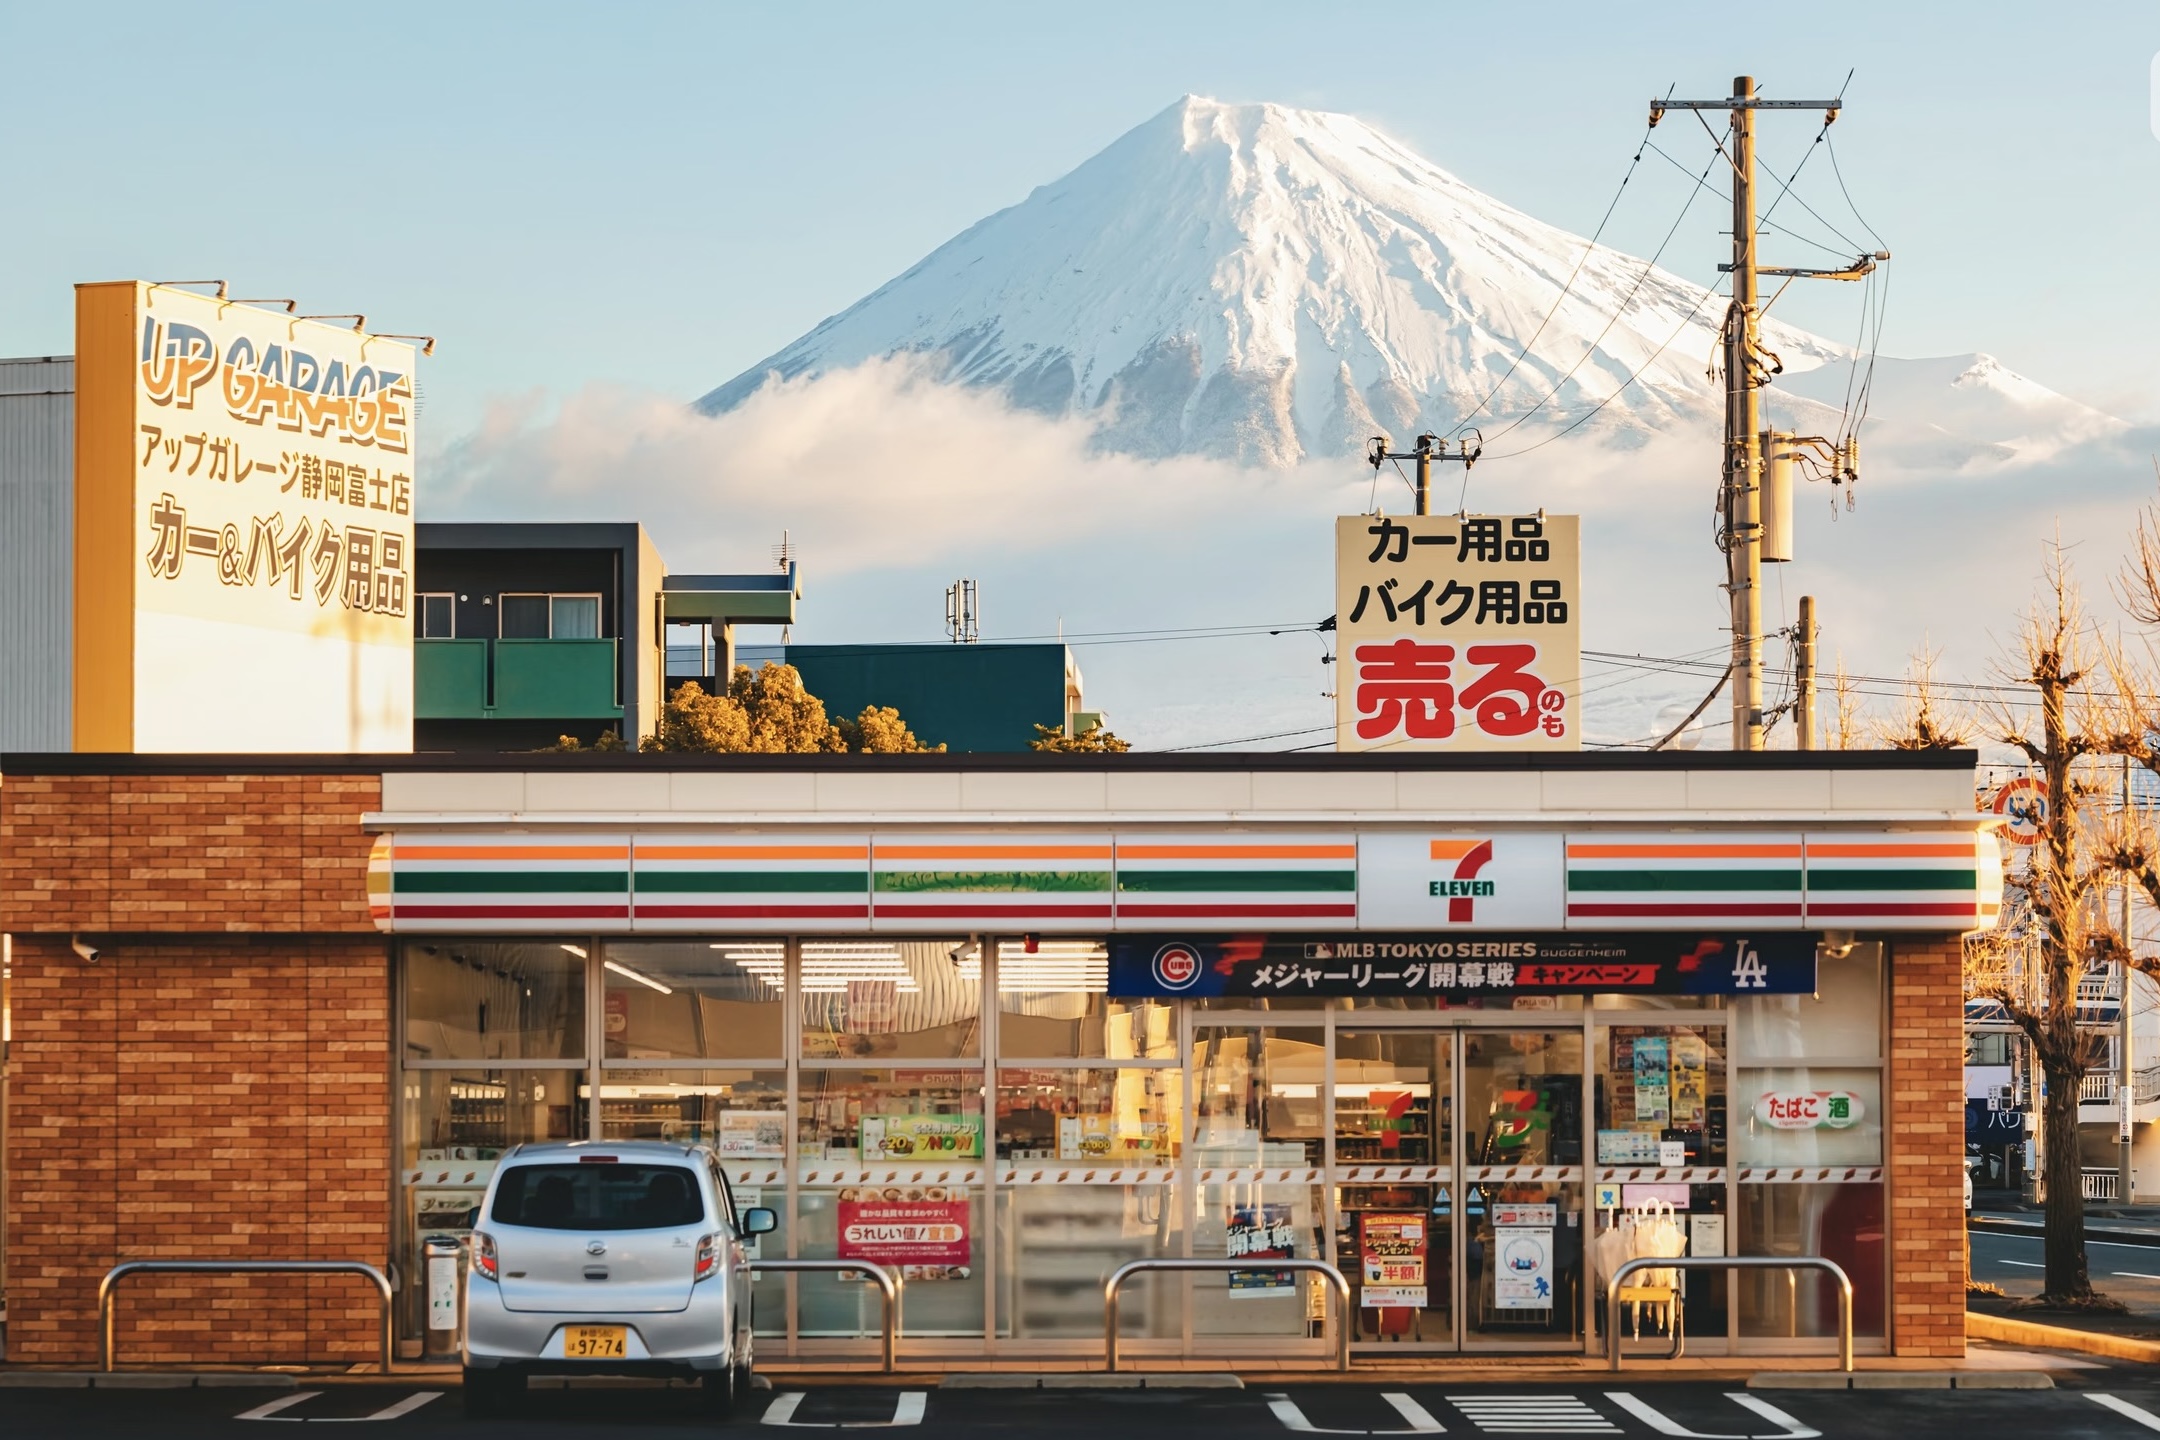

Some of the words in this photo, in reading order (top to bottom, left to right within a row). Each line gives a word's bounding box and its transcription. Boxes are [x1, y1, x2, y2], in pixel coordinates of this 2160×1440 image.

[141, 314, 218, 411] UP
[221, 336, 411, 455] GARAGE
[140, 423, 410, 516] アップガレージ静岡富士店
[1368, 518, 1550, 563] カー用品
[1349, 577, 1568, 626] バイク用品
[2009, 796, 2046, 826] 50
[1430, 839, 1493, 922] 7
[1161, 949, 1195, 983] CUBS
[1336, 943, 1375, 958] MLB
[1379, 943, 1454, 958] TOKYO
[1456, 942, 1537, 958] SERIES
[1731, 939, 1768, 988] LA
[1250, 962, 1515, 989] メジャーリーグ開幕戦
[1531, 965, 1641, 984] キャンペーン
[1769, 1097, 1819, 1119] たばこ
[1828, 1097, 1850, 1118] 酒
[578, 1339, 623, 1355] 97-74
